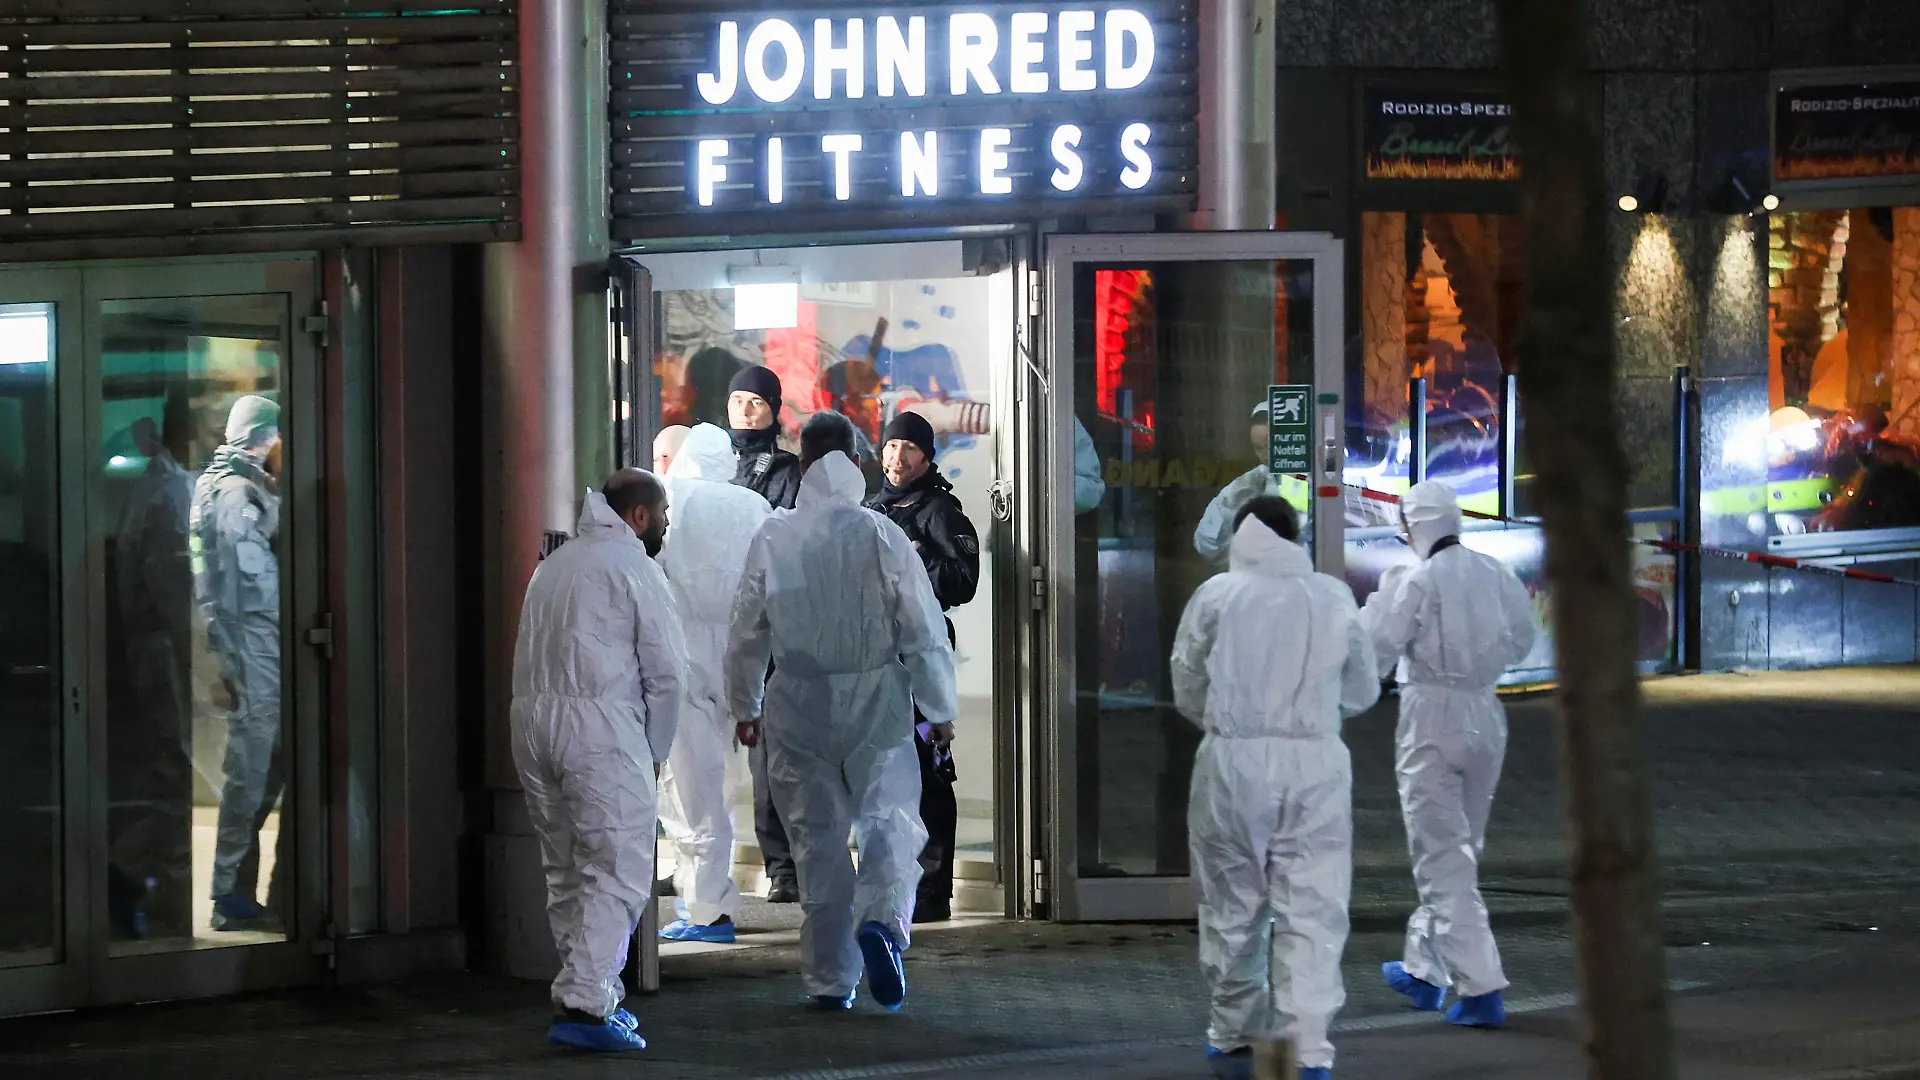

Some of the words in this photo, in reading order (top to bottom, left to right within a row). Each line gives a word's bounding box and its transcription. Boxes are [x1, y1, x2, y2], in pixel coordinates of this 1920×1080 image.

[696, 15, 926, 105] JOHN
[949, 9, 1155, 96] REED
[697, 122, 1153, 207] FITNESS
[1274, 433, 1291, 442] nur
[1291, 432, 1306, 441] im
[1274, 445, 1306, 455] Notfall
[1274, 458, 1306, 469] öffnen
